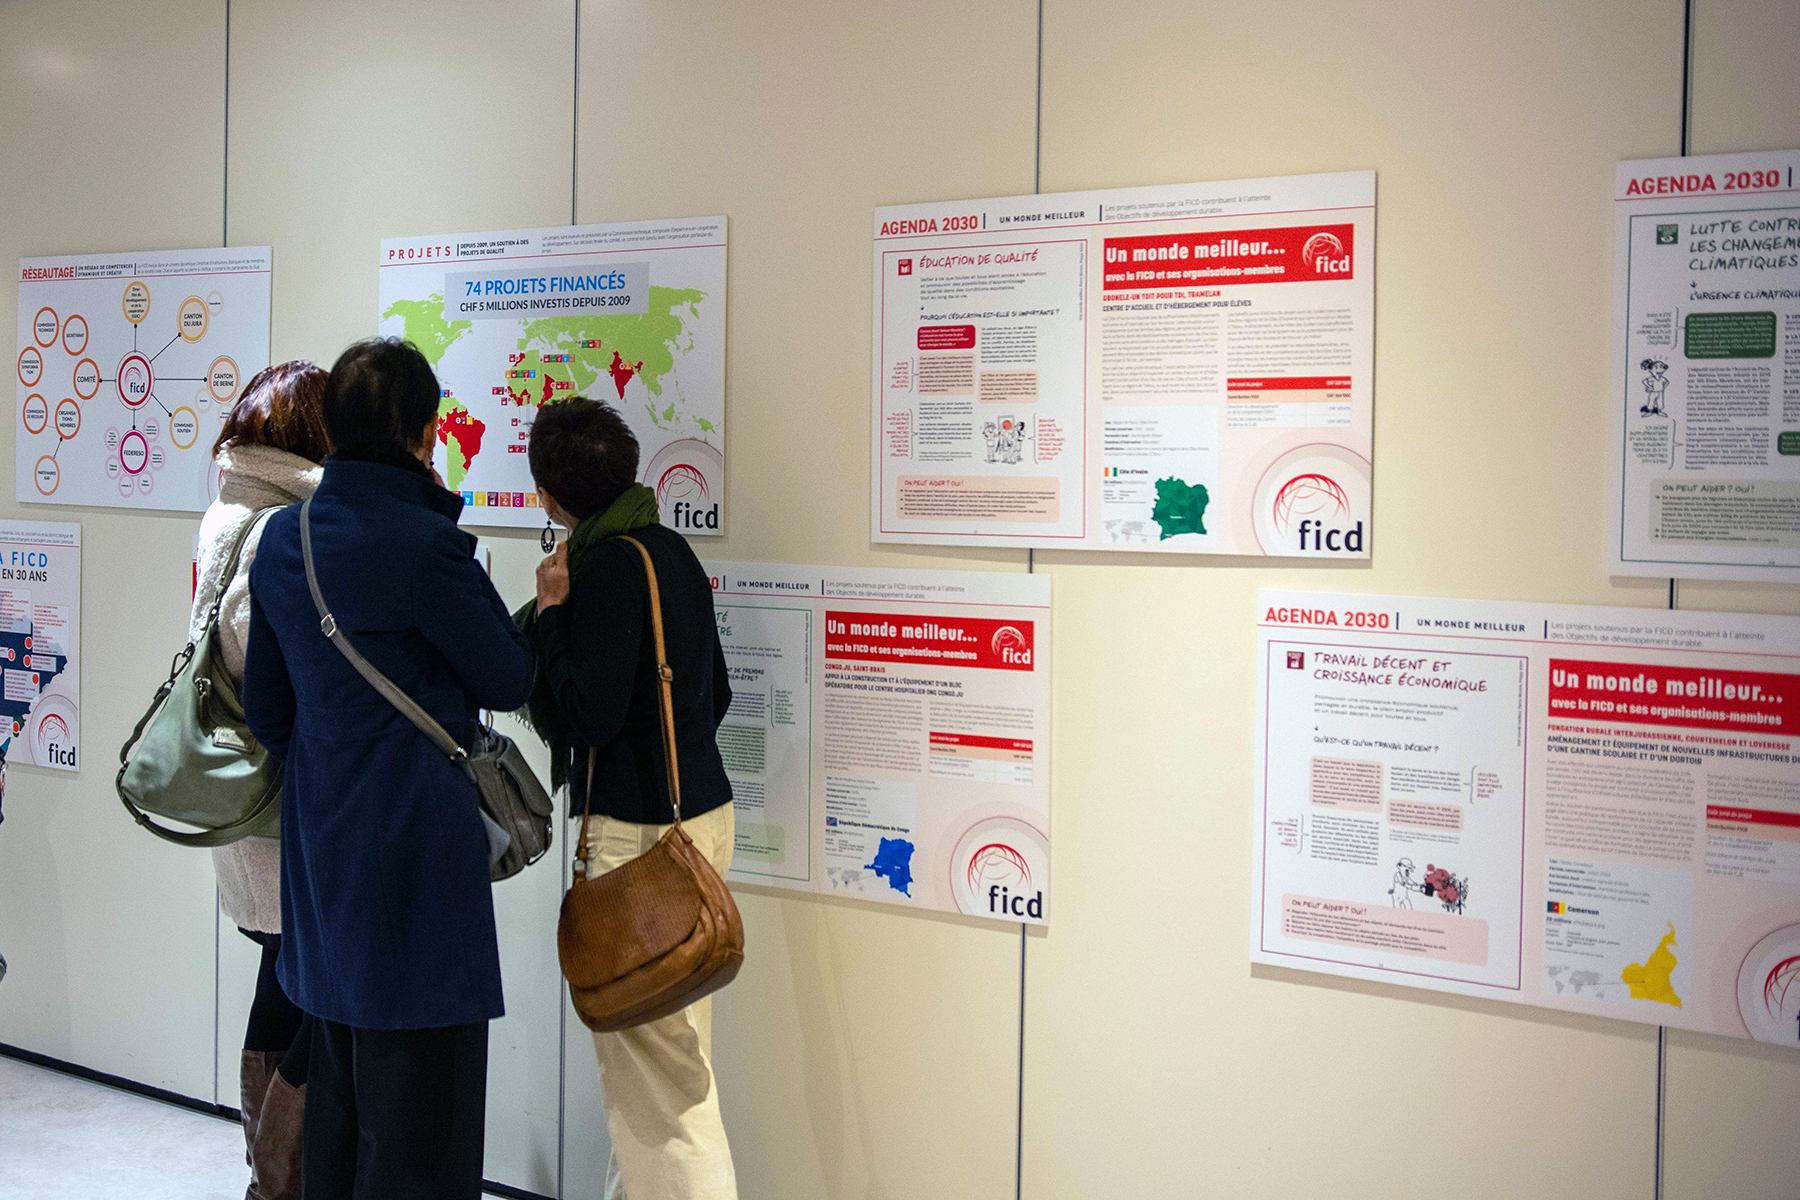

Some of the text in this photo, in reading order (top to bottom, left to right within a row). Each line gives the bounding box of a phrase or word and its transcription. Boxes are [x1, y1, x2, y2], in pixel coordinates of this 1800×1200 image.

[1626, 170, 1780, 195] AGENDA 2030
[881, 216, 978, 235] AGENDA 2030
[1014, 214, 1041, 222] MONDE
[1045, 211, 1085, 221] MEILLEUR
[1690, 221, 1741, 235] LUTTE
[389, 246, 451, 259] PROJETS
[1106, 239, 1285, 263] Un monde meilleur...
[1690, 240, 1716, 253] LES
[919, 248, 1039, 268] ÉDUCATION DE QUALITÉ
[1315, 255, 1350, 273] ficd
[1689, 255, 1798, 270] CLIMATIQUES
[22, 266, 74, 279] RÉSEAUTAGE
[1105, 264, 1285, 282] avec la FICD et ses organisations-membres
[465, 270, 626, 296] 74 PROJETS FINANCÉS
[460, 295, 631, 312] CHF 5 MILLIONS INVESTIS DEPUIS 2009
[1690, 291, 1741, 300] L'URGENCE
[1103, 299, 1252, 312] CENTRE D'ACCUEIL ET D'HÉBERGEMENT POUR ÉLÈVES
[130, 382, 145, 393] ficd
[674, 502, 719, 529] ficd
[1299, 520, 1363, 552] ficd
[12, 551, 48, 567] FICD
[2, 569, 47, 582] EN 30 ANS
[1265, 607, 1390, 628] AGENDA 2030
[1417, 618, 1526, 632] UN MONDE MEILLEUR
[828, 620, 978, 642] Un monde meilleur...
[827, 643, 978, 660] avec la FICD et ses organisations-membres
[1002, 648, 1031, 664] ficd
[1313, 652, 1452, 672] TRAVAIL DÉCENT ET
[852, 675, 887, 683] CONSTRUCTION
[1314, 669, 1488, 692] CROISSANCE ÉCONOMIQUE
[1552, 669, 1783, 703] Un monde meilleur...
[1551, 698, 1782, 726] avec la FICD et ses organisations-membres
[48, 743, 76, 766] ficd
[1547, 745, 1568, 753] D'UNE
[1570, 747, 1601, 756] CANTINE
[1603, 750, 1638, 759] SCOLAIRE
[1670, 755, 1702, 764] DORTOIR
[1548, 735, 1600, 747] AMÉNAGEMENT
[1613, 739, 1658, 752] ÉQUIPEMENT
[1672, 746, 1715, 756] NOUVELLES
[1717, 750, 1789, 763] INFRASTRUCTURES
[988, 885, 1043, 919] ficd
